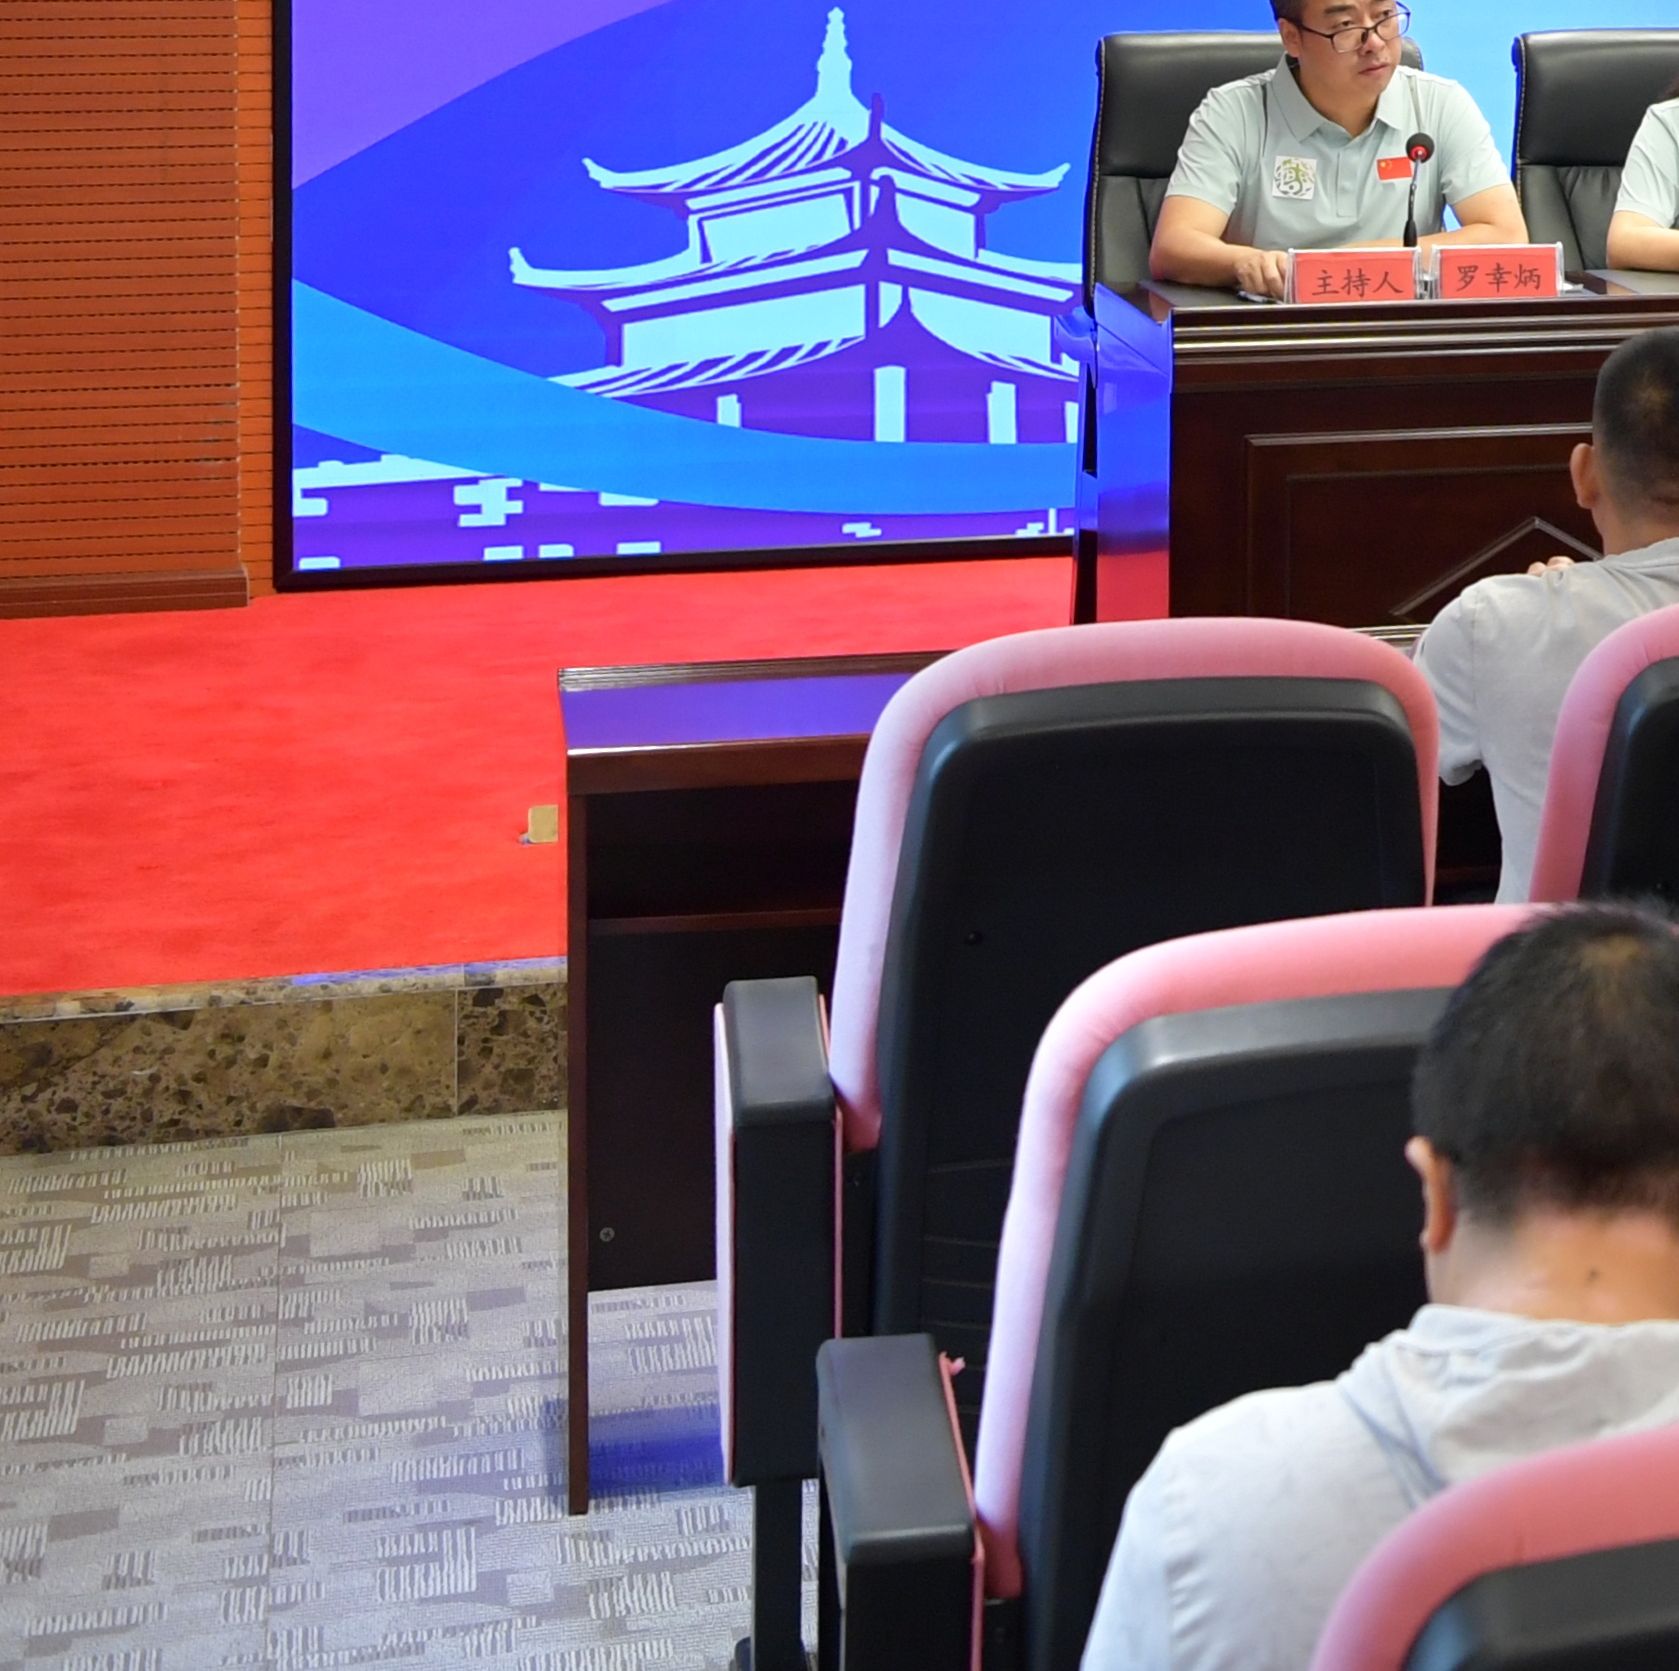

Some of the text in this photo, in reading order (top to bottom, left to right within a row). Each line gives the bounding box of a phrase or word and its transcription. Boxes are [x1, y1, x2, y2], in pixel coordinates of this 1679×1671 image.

[1310, 267, 1405, 299] 主持人
[1455, 262, 1543, 293] 罗幸炳
